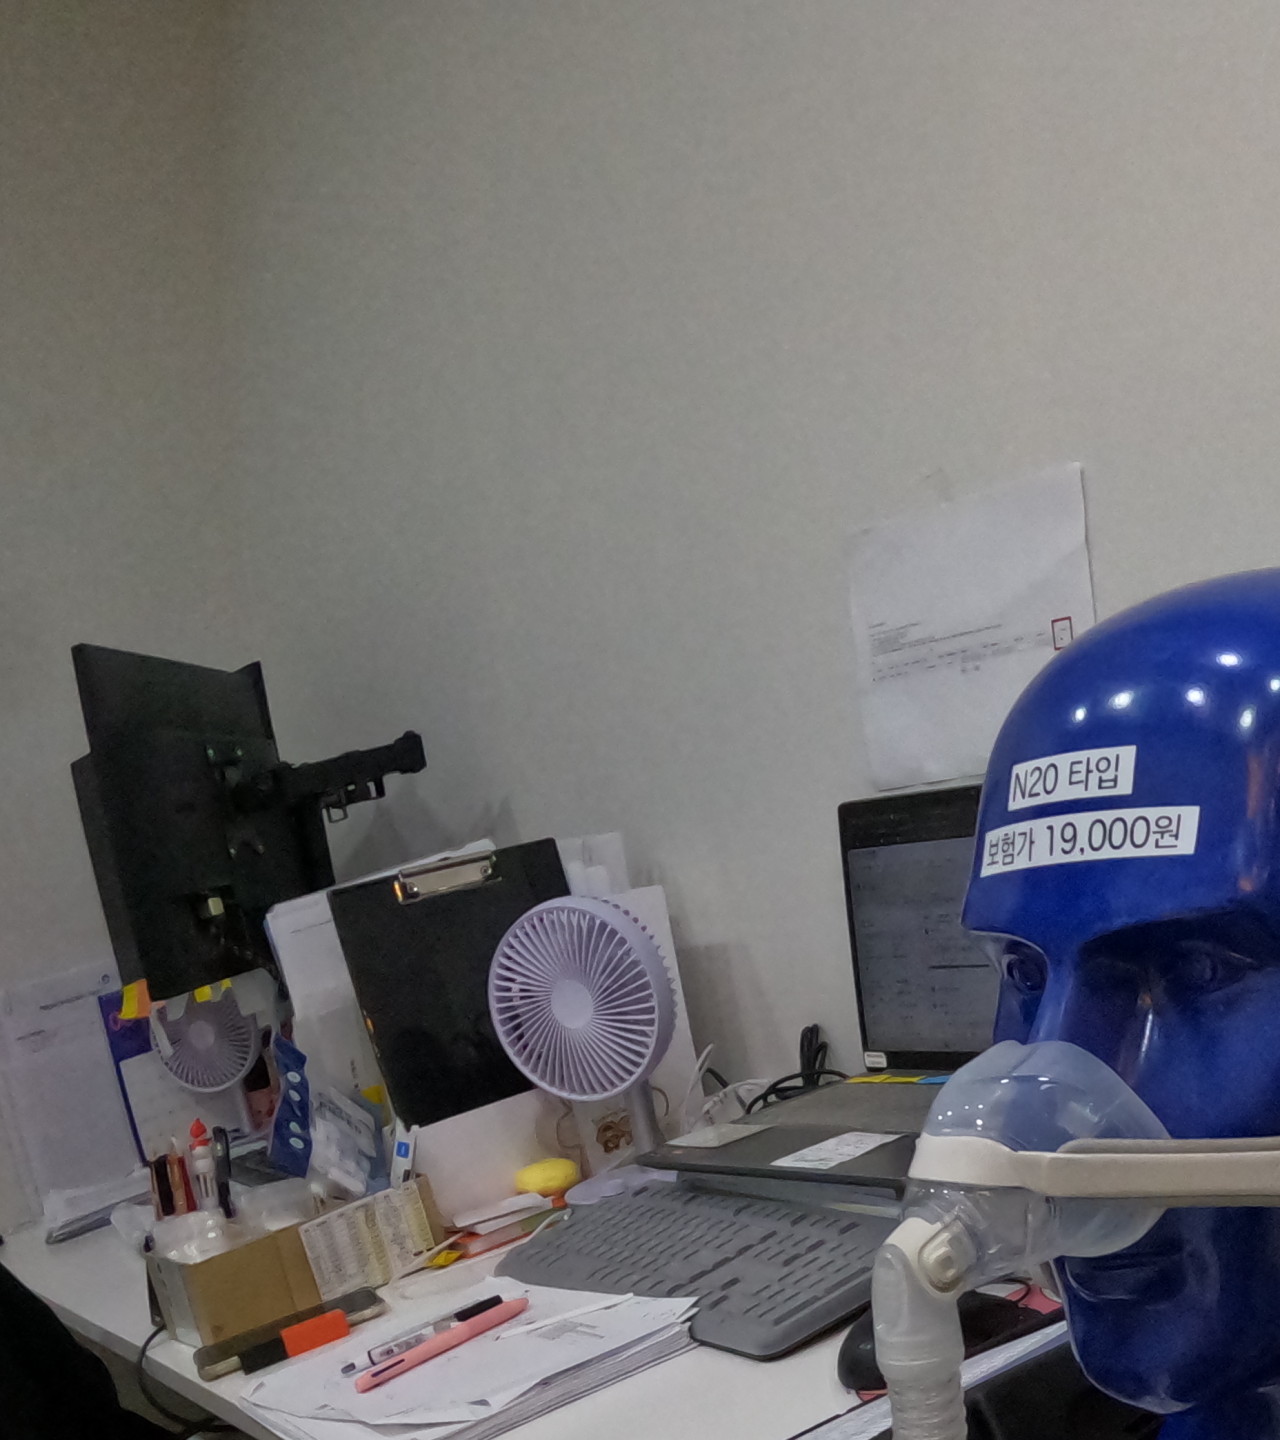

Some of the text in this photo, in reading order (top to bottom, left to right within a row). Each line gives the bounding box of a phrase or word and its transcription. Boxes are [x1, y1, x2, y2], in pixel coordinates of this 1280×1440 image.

[1011, 754, 1121, 802] N20 타입
[985, 813, 1182, 867] 보험가 19,000원
